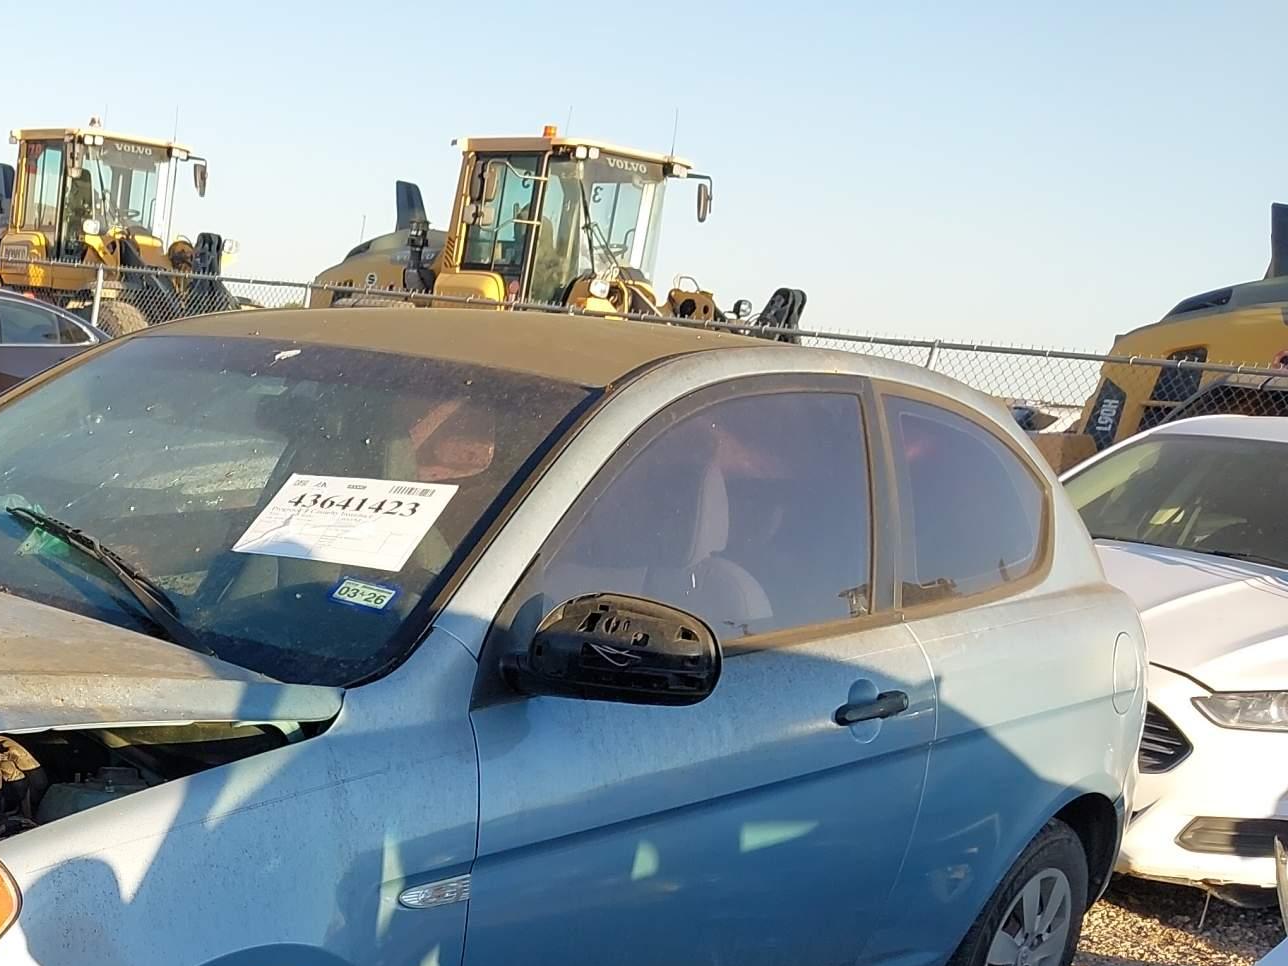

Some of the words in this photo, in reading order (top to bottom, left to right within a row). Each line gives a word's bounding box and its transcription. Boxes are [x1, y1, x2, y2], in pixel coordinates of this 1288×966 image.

[114, 143, 153, 156] VOLVO
[606, 157, 647, 174] VOLVO
[288, 492, 421, 517] 43641423
[338, 586, 360, 599] 03
[363, 592, 387, 605] 26
